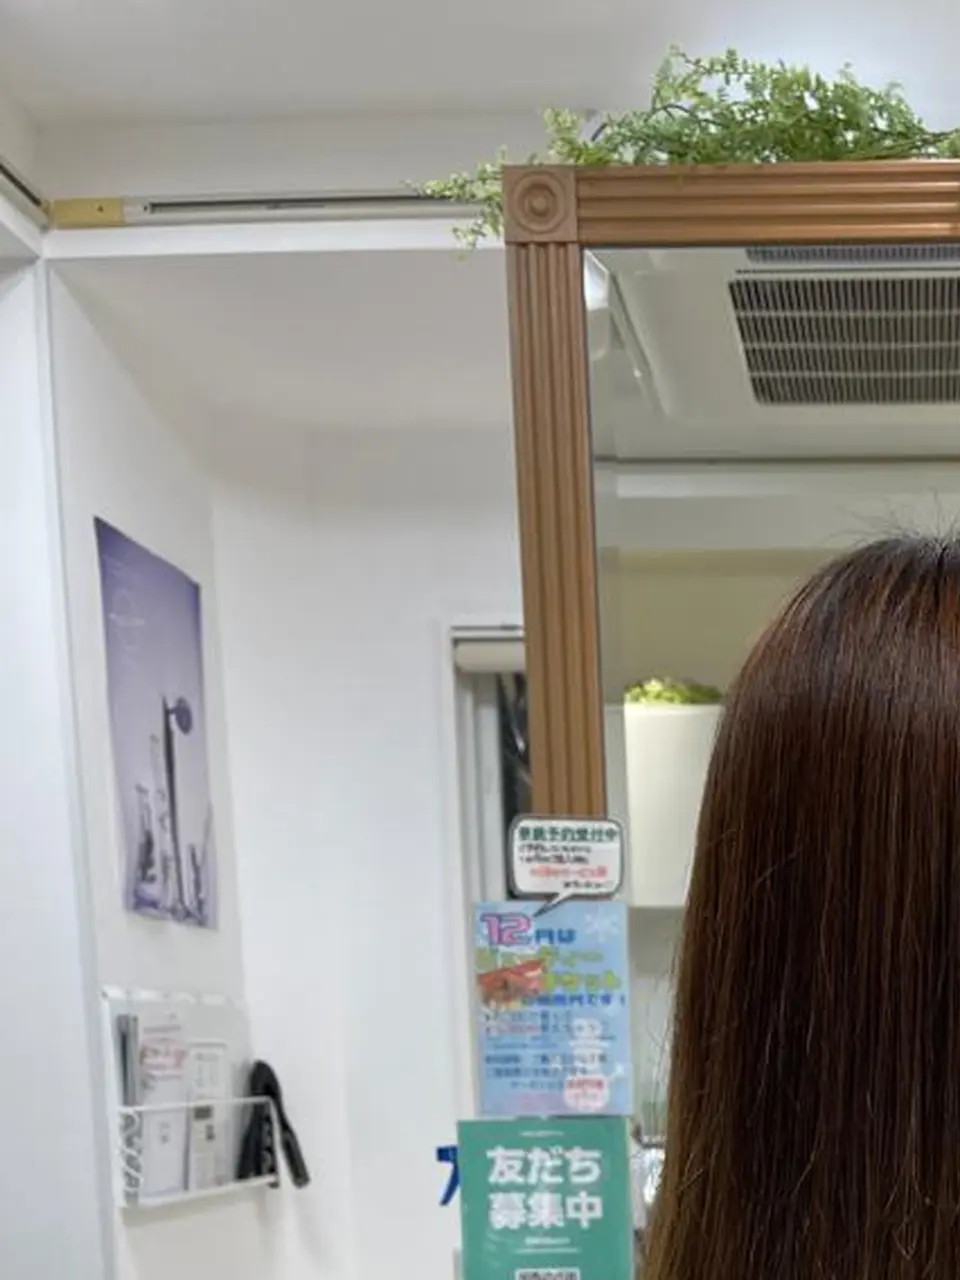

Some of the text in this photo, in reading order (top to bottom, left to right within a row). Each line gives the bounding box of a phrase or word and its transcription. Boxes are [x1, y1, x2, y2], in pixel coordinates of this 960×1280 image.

[486, 1144, 602, 1185] 友だち
[488, 1190, 604, 1230] 募集中
